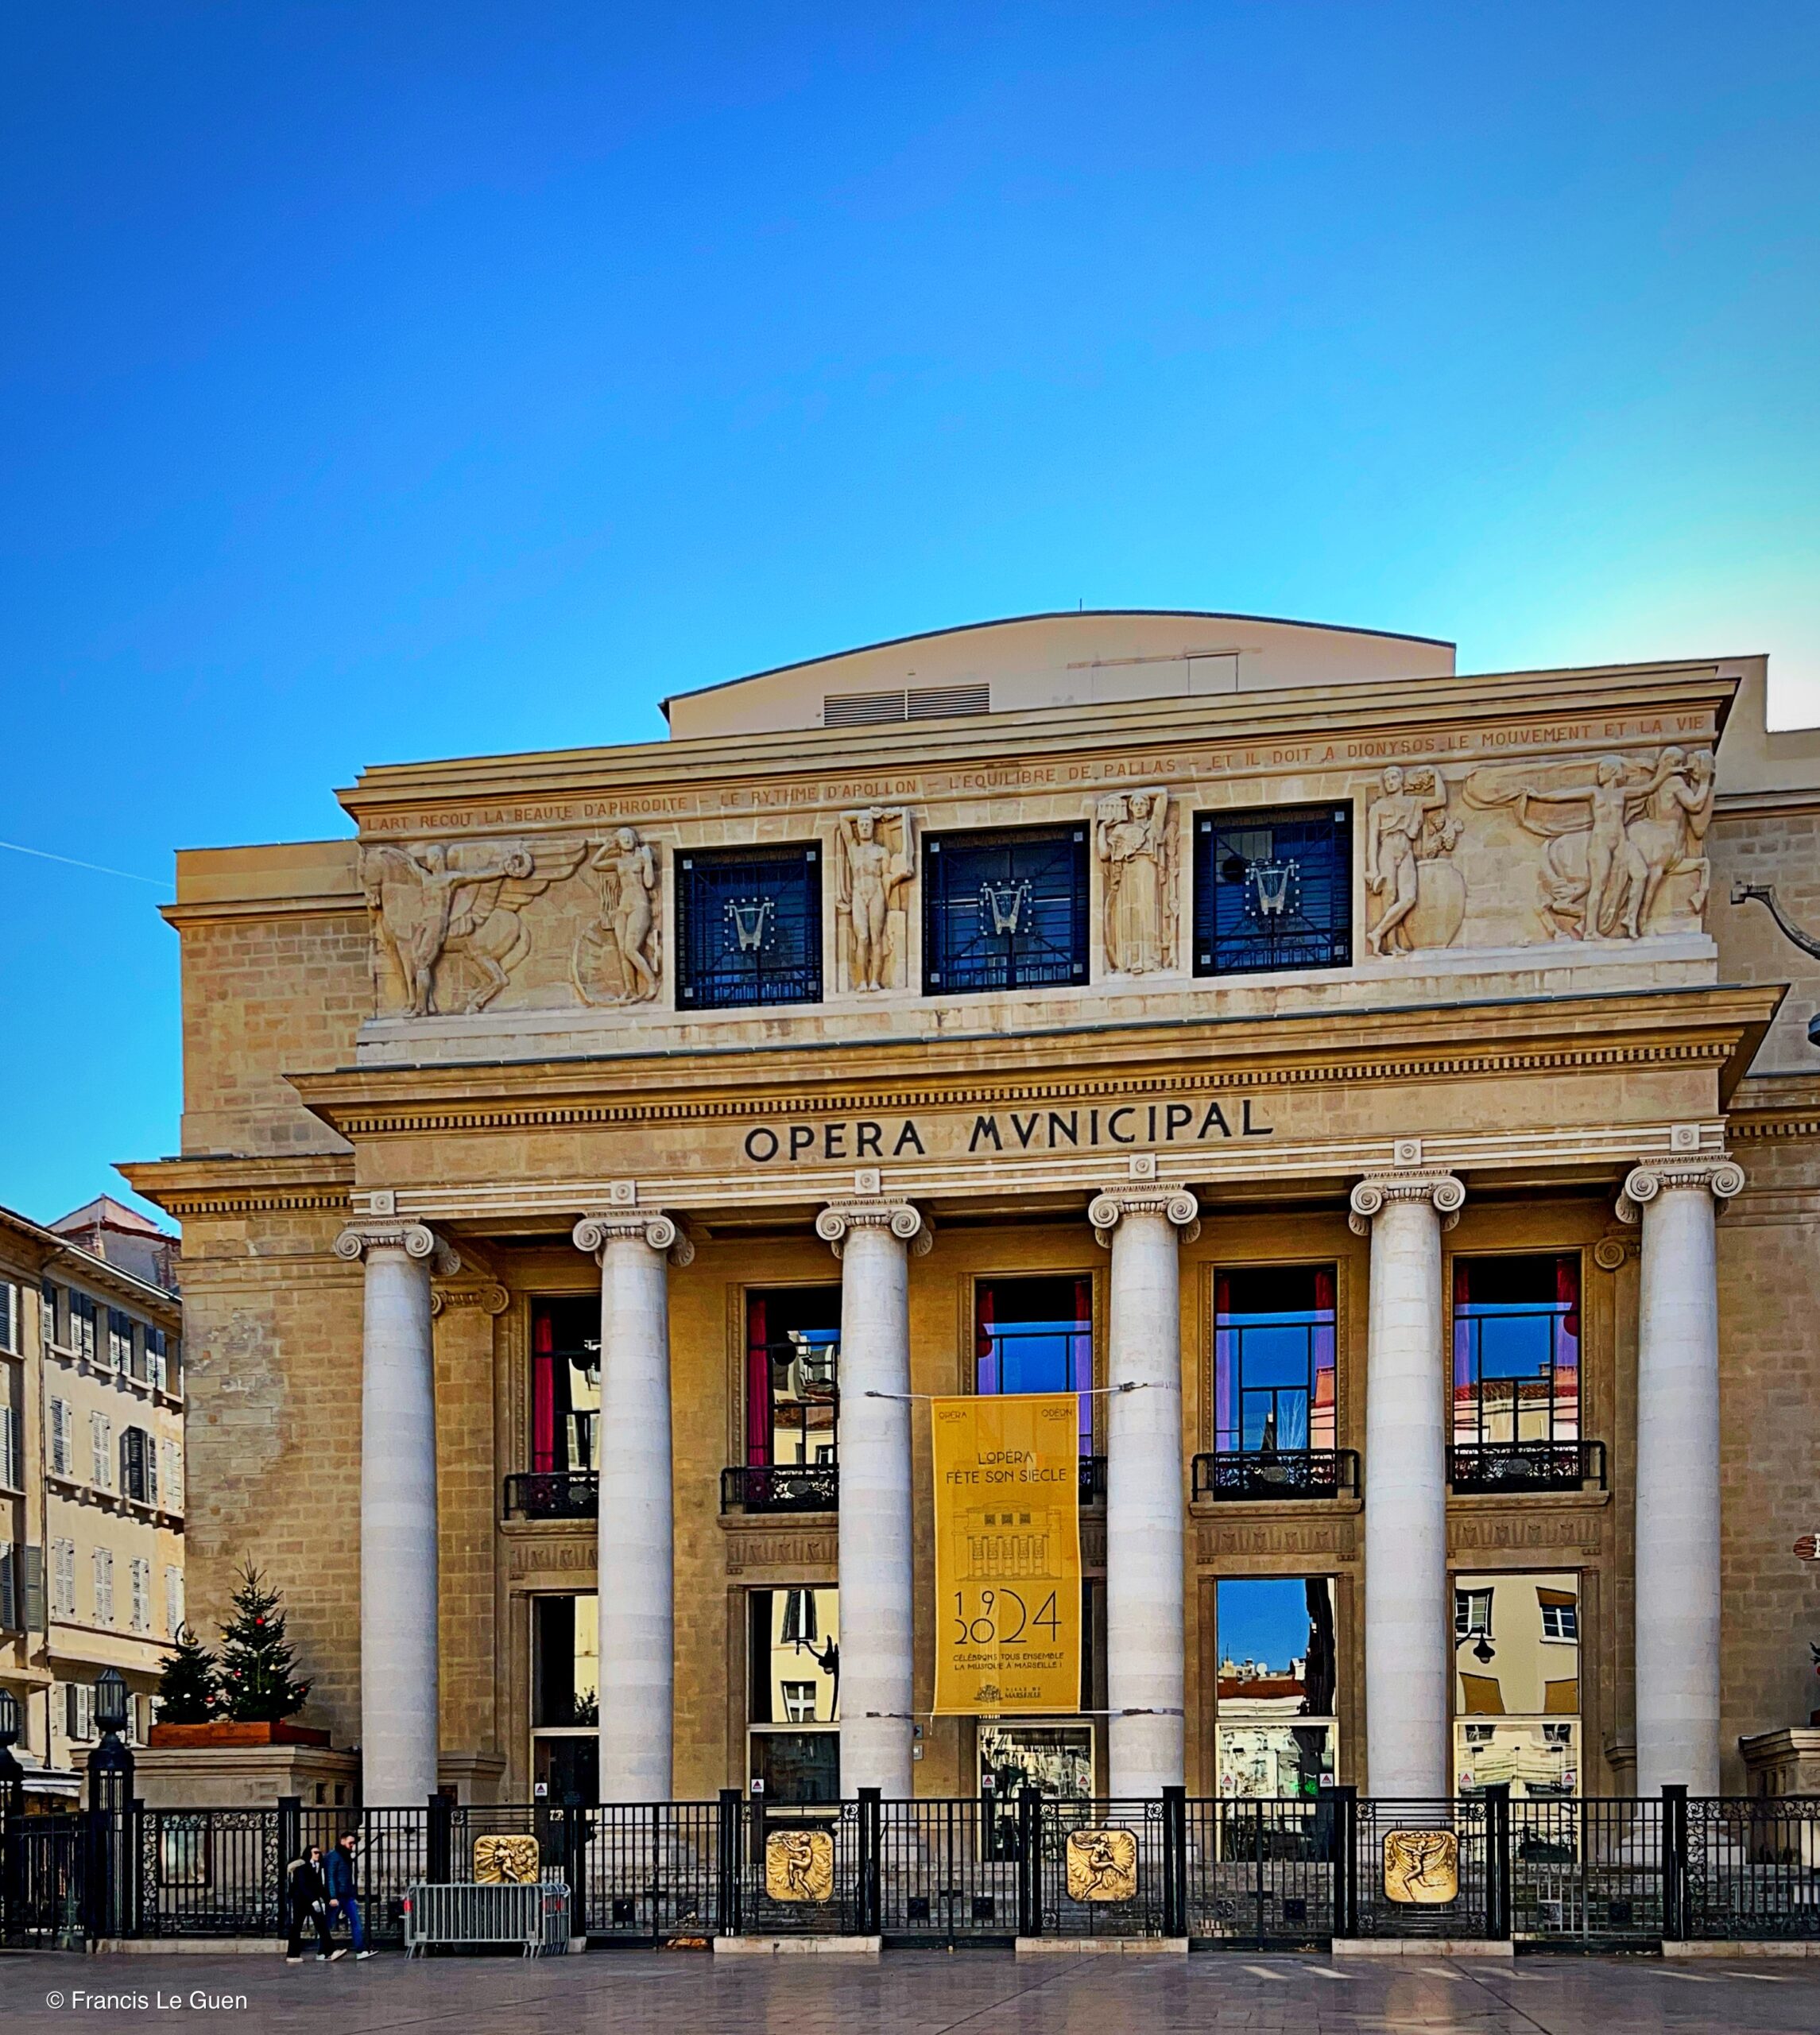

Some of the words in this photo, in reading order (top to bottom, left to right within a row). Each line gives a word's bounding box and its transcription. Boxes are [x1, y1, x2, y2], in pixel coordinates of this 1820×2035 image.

[368, 816, 409, 831] L'ART
[485, 810, 504, 824] LA
[516, 804, 572, 822] BEAUTE
[584, 797, 687, 816] D'APHRODITE
[720, 793, 739, 806] LE
[752, 786, 816, 804] RYTHME
[827, 780, 916, 798] D'APOLLON
[950, 768, 1055, 789] L'EQUILIBRE
[1069, 766, 1091, 780] DE
[1104, 759, 1175, 777] PALLAS
[1212, 754, 1233, 769] ET
[1246, 752, 1260, 766] IL
[1272, 747, 1312, 764] DOIT
[1325, 746, 1335, 760] A
[1348, 736, 1435, 758] DIONYSOS
[1447, 735, 1469, 750] LE
[1482, 725, 1592, 746] MOUVEMENT
[1605, 723, 1627, 737] ET
[1640, 719, 1663, 734] LA
[1676, 715, 1705, 731] VIE
[745, 1120, 926, 1163] OPERA
[968, 1099, 1274, 1153] MVNICIPAL
[947, 1469, 979, 1484] FÊTE
[986, 1471, 1013, 1483] SON
[1023, 1652, 1064, 1661] ENSEMBLE
